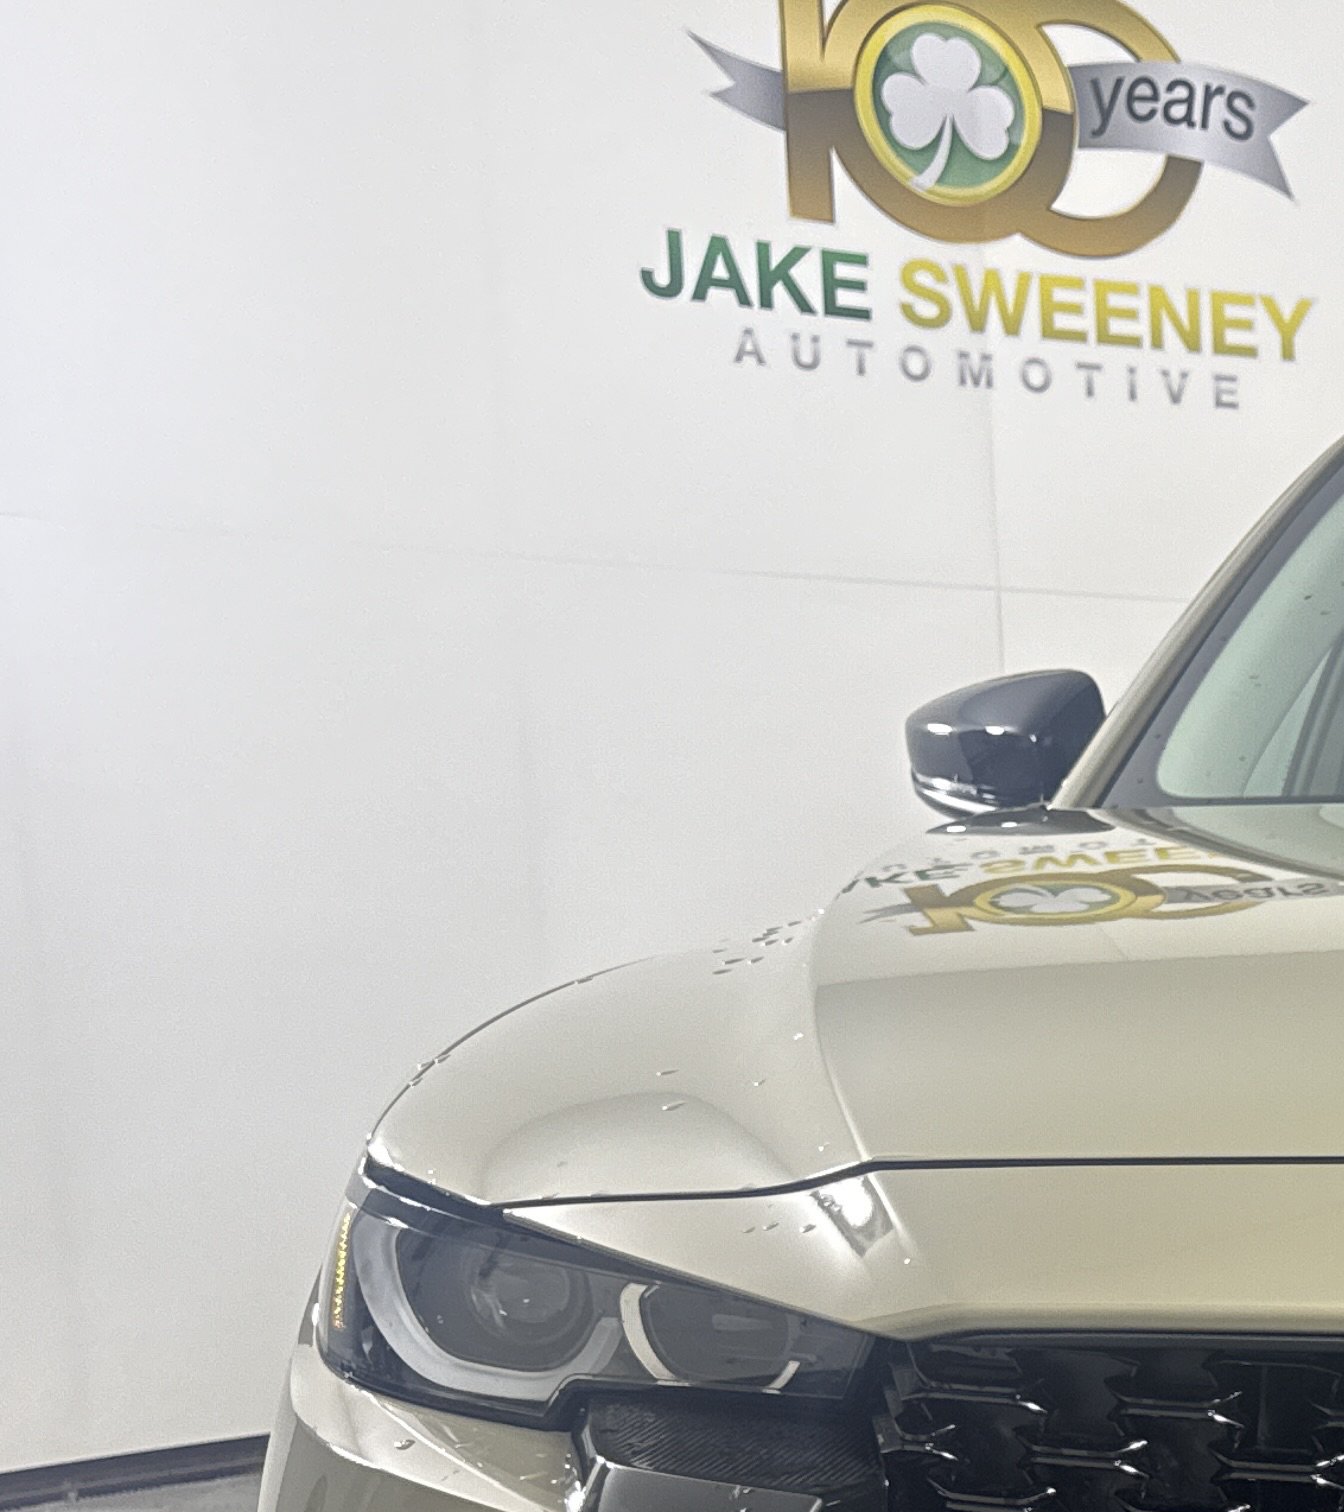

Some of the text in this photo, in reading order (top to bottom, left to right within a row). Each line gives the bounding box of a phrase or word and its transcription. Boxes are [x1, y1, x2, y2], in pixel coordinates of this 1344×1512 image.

[1088, 74, 1256, 141] years
[640, 229, 1313, 362] JAKE SWEENEY
[733, 328, 1240, 410] AUTOMOTIVE
